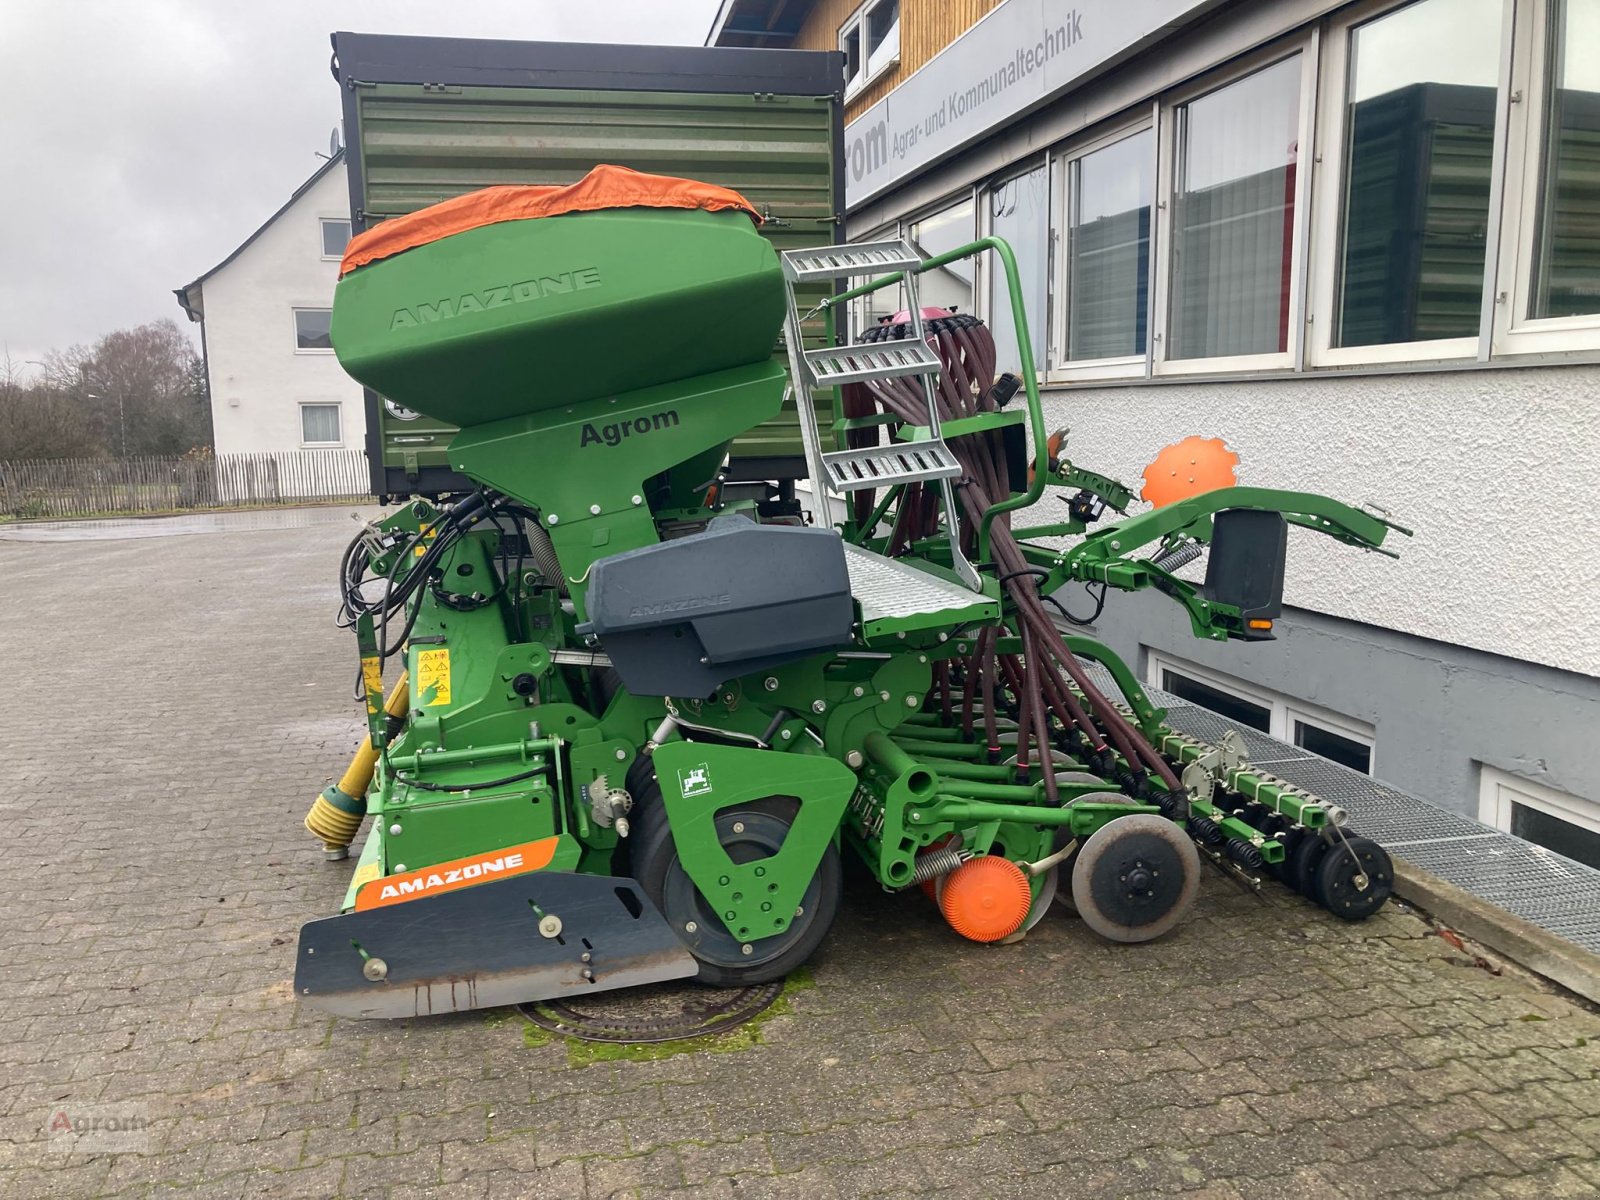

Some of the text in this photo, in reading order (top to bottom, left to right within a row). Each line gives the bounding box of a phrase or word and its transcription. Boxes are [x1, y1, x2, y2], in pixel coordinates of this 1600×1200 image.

[892, 124, 923, 160] Agrar-
[925, 100, 946, 137] und
[949, 9, 1083, 122] Kommunaltechnik
[390, 266, 602, 331] AMAZONE
[580, 409, 680, 448] Agrom
[630, 592, 732, 618] AMAZONE
[380, 853, 524, 900] AMAZONE
